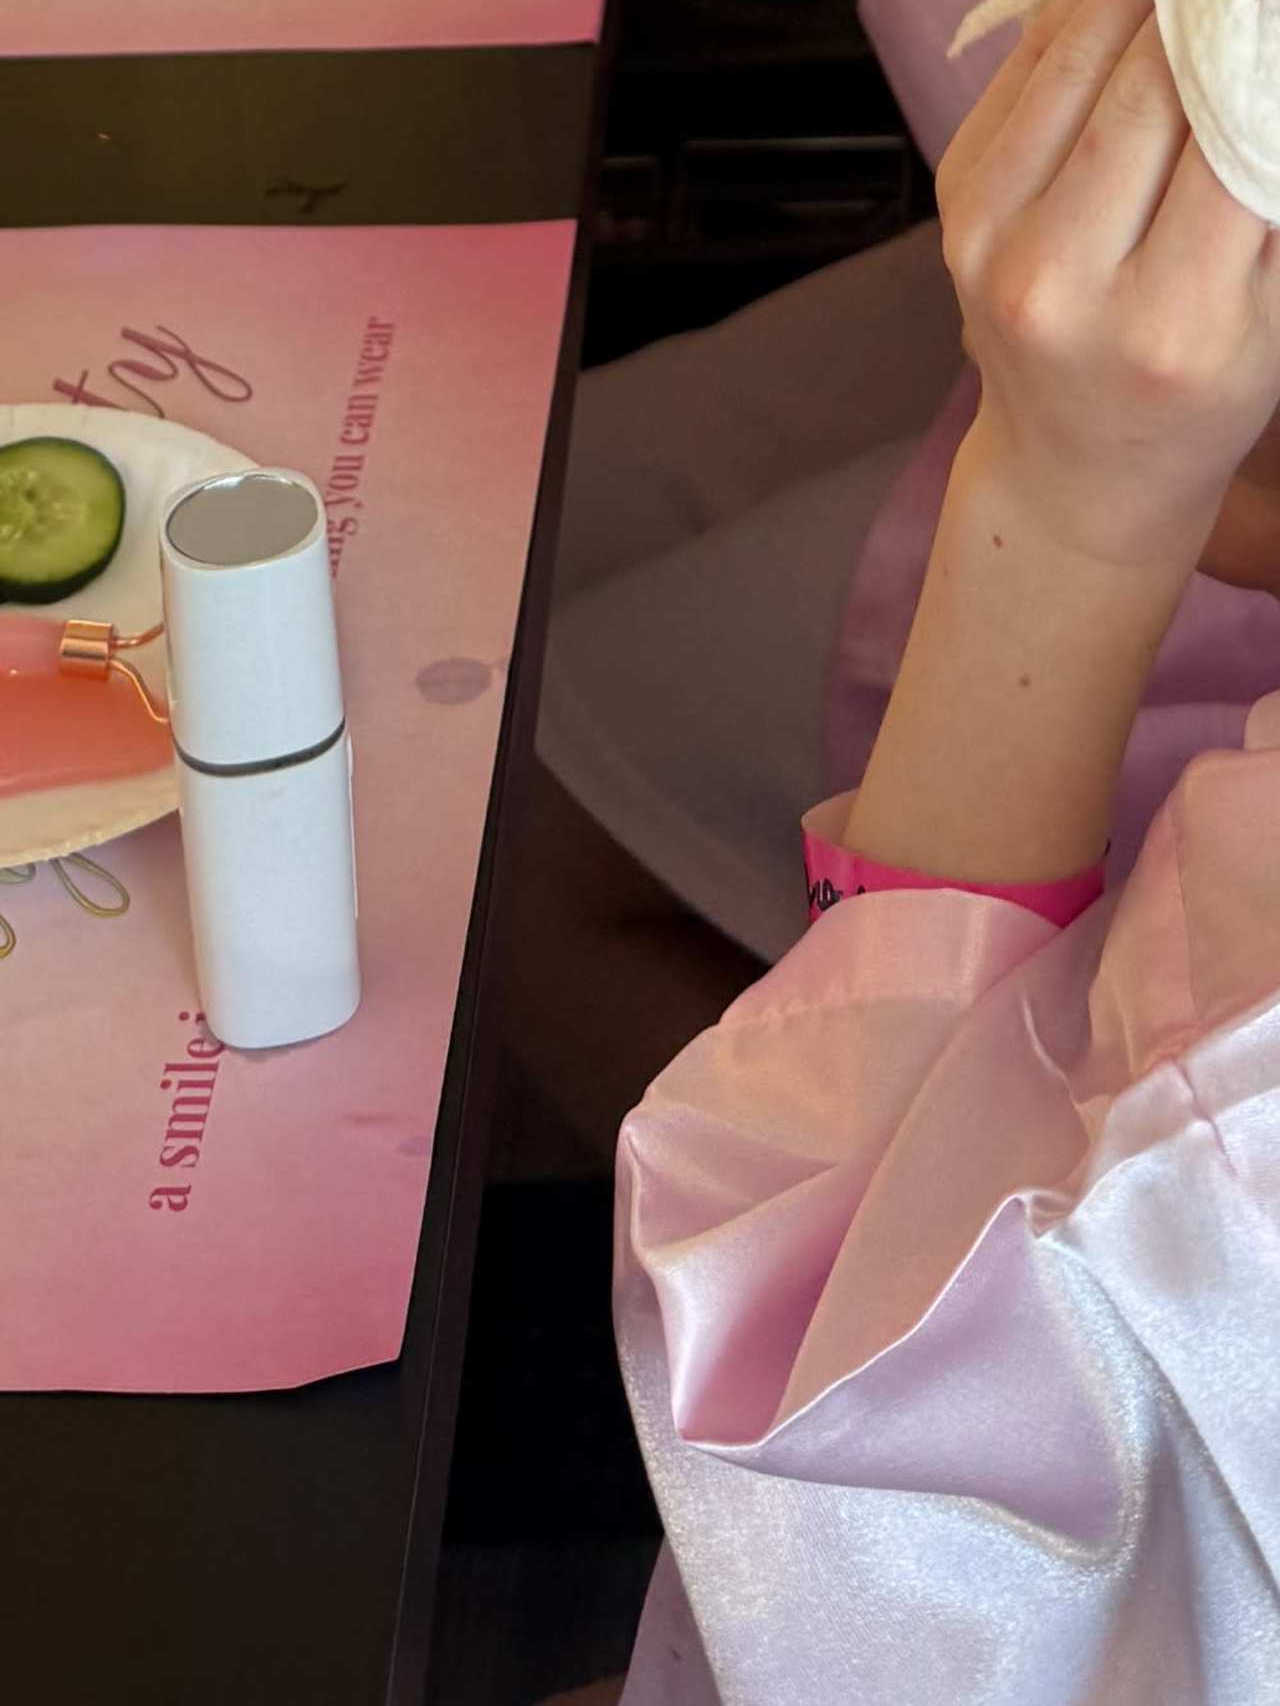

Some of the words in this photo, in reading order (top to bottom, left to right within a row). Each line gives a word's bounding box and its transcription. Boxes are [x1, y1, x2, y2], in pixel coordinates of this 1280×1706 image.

[353, 316, 396, 387] wear
[339, 394, 378, 445] can
[324, 455, 363, 508] you
[159, 1038, 227, 1168] smile
[149, 1183, 192, 1212] a
